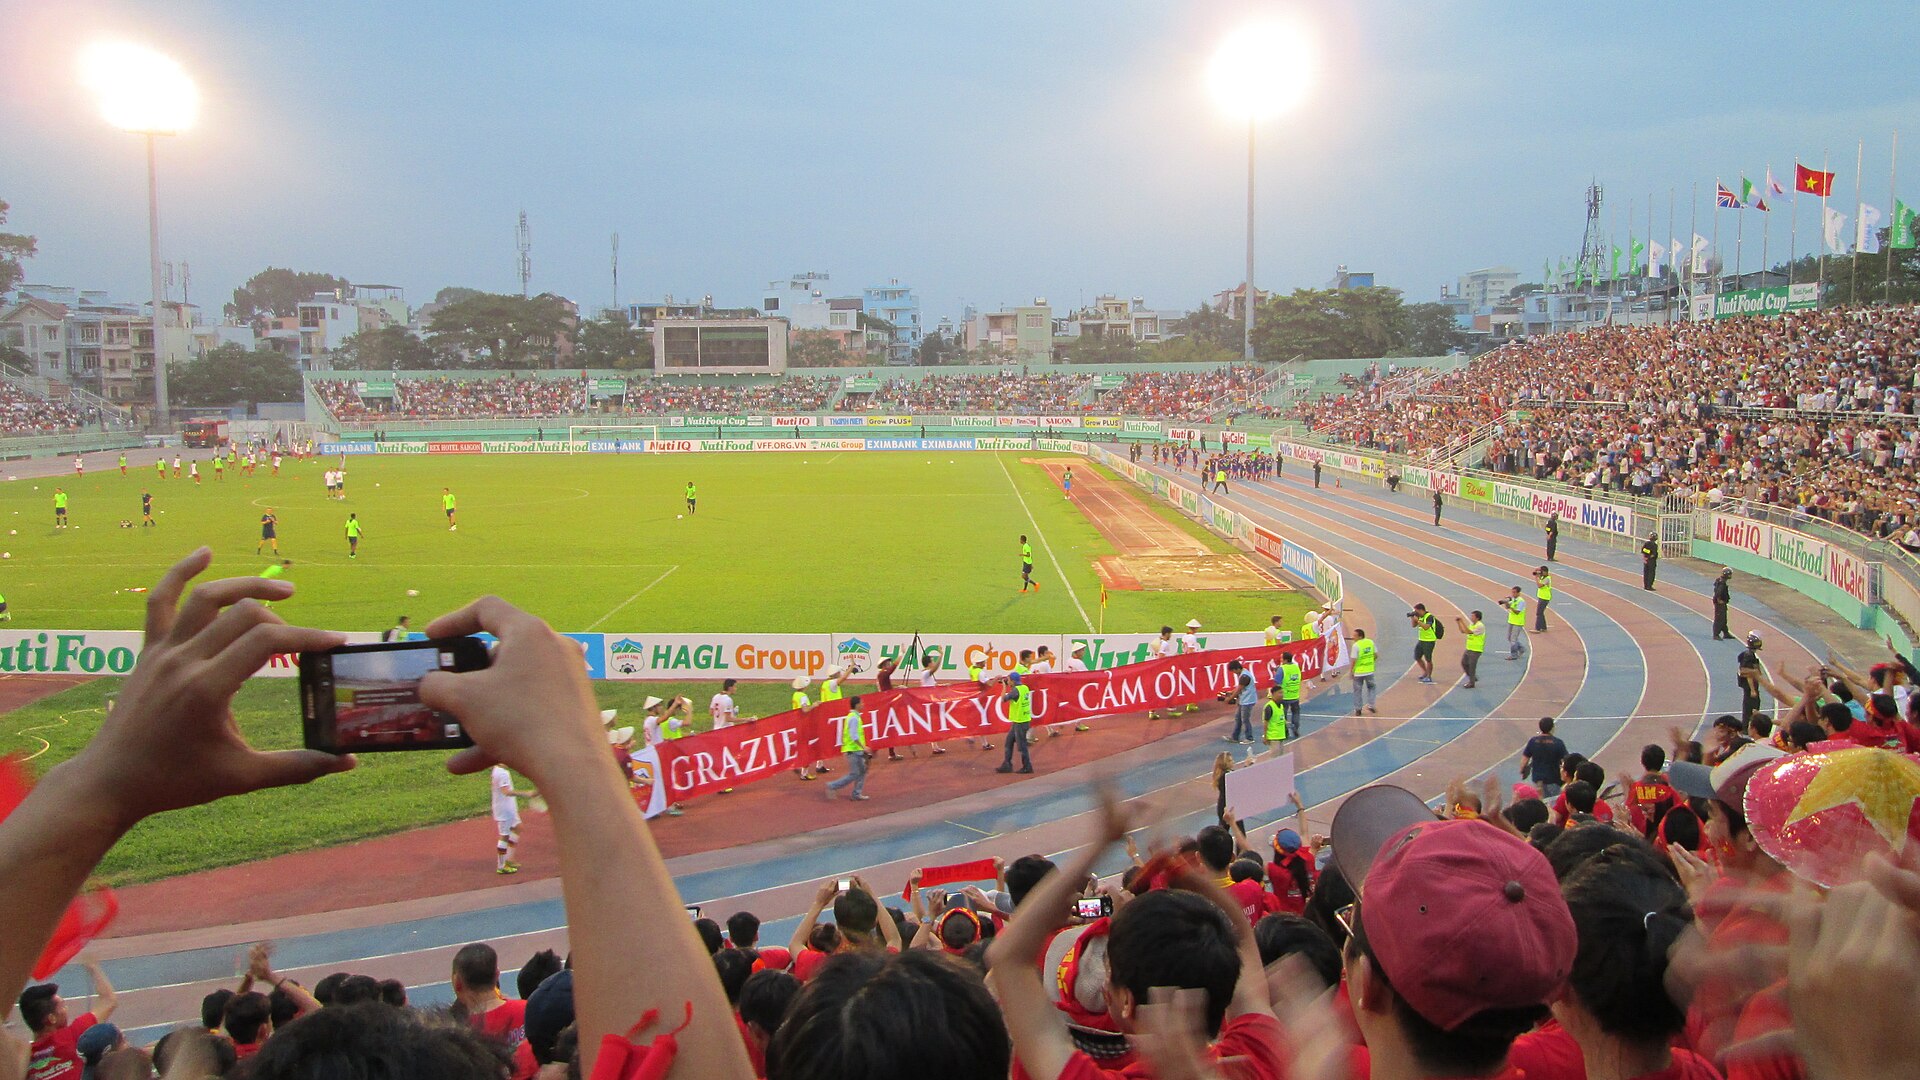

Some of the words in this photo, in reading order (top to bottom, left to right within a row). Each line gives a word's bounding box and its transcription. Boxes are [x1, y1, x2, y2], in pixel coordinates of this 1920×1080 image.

[1716, 292, 1764, 315] NutiFood
[1765, 293, 1788, 312] Cup
[686, 416, 728, 425] NutiFood
[728, 416, 745, 426] Cup
[952, 417, 993, 426] NutiFood
[1085, 419, 1101, 427] Grow
[1125, 421, 1160, 432] NutiFood
[324, 444, 373, 453] EXIMBANK
[376, 442, 428, 453] NutiFood
[441, 443, 459, 452] HOTEL
[460, 443, 481, 452] SAIGON
[482, 441, 535, 453] NutiFood
[591, 442, 641, 451] EXIMANK
[700, 440, 754, 451] NutiFood
[841, 442, 864, 450] Group
[867, 441, 918, 449] EXIMBANK
[921, 441, 972, 449] EXIMBANK
[976, 439, 1031, 450] NutiFood
[1037, 439, 1071, 451] NutiFood
[1402, 466, 1429, 487] NutiFood
[1430, 471, 1458, 495] NuCalci
[1494, 485, 1531, 511] NutiFood
[1582, 503, 1625, 533] NuVita
[1772, 532, 1825, 577] NutiFood
[1283, 543, 1314, 579] EXIMBANK
[1830, 551, 1865, 602] NuCalci
[0, 632, 141, 673] utiFoo
[964, 644, 1055, 672] Gro
[651, 644, 729, 670] HAGL
[735, 643, 825, 676] Group
[671, 727, 798, 791] GRAZIE
[827, 699, 967, 747] THANK
[1078, 670, 1147, 711] CẢM
[1154, 666, 1197, 702] ƠN
